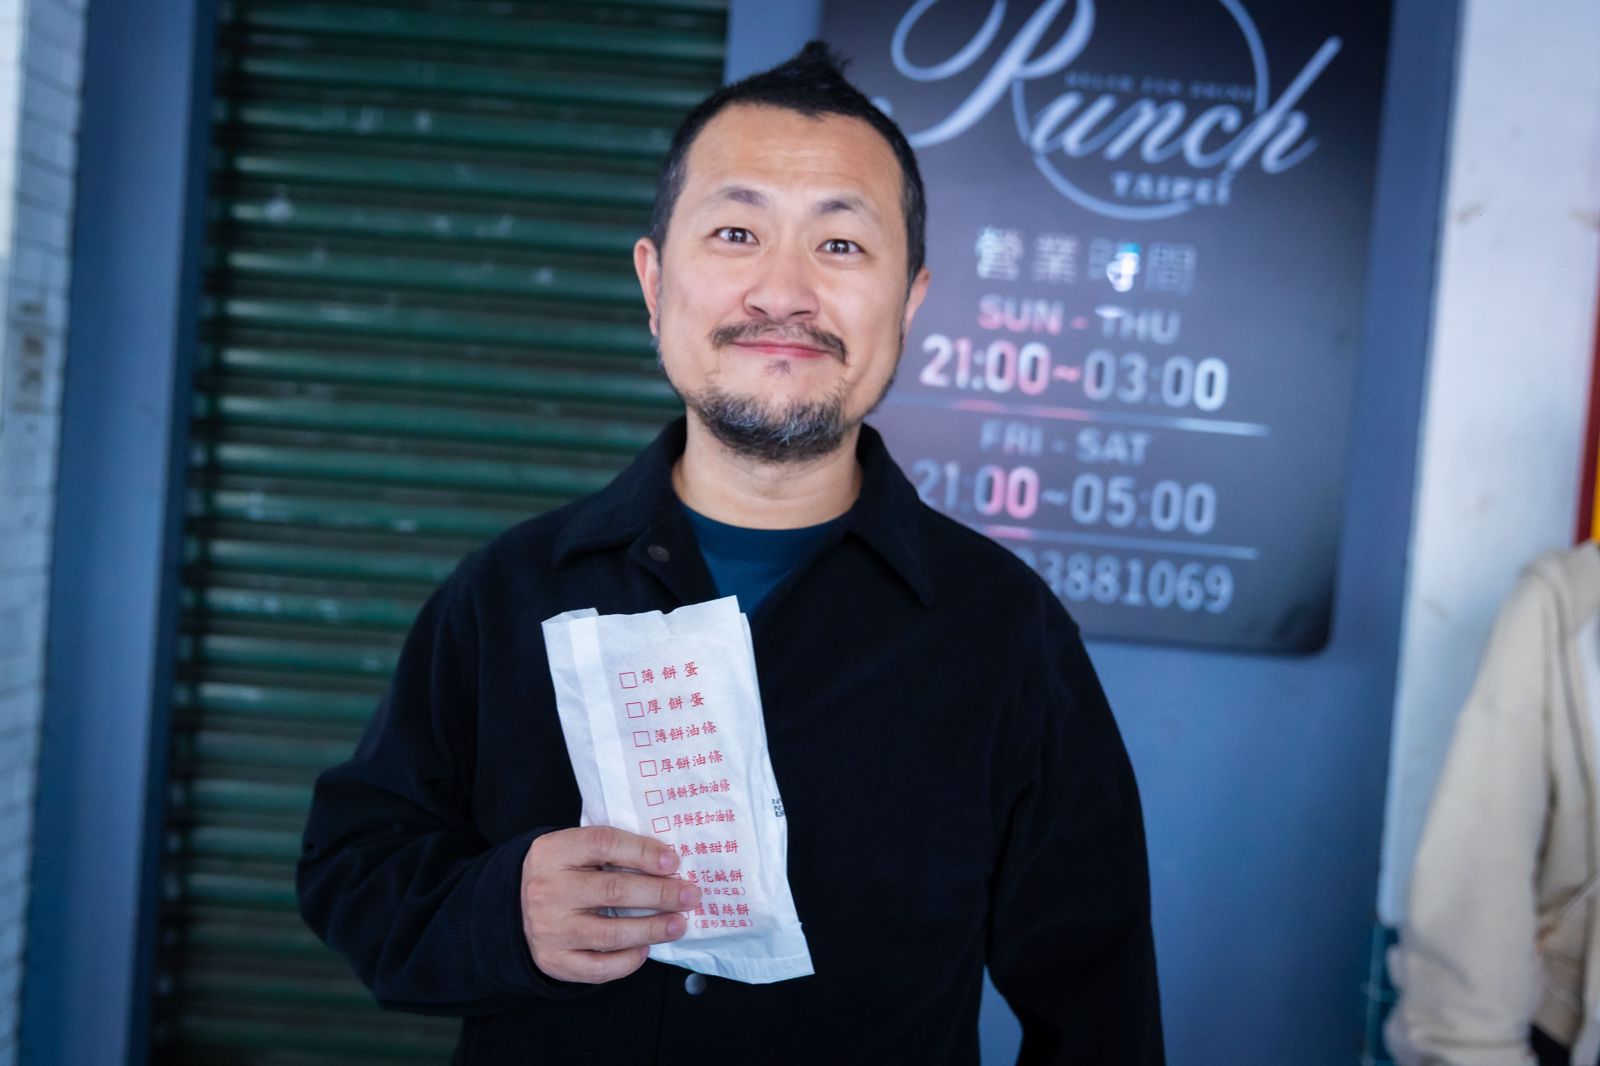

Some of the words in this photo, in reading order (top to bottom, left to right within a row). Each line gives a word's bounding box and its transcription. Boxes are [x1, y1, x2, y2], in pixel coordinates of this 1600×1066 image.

[1111, 170, 1233, 206] TAIPEI
[979, 295, 1063, 335] SUN
[1096, 306, 1181, 344] THU
[979, 420, 1043, 457] FRI
[1076, 425, 1151, 465] SAT
[1016, 548, 1235, 613] 3881069
[641, 661, 699, 683] 薄餅蛋
[648, 692, 704, 713] 厚餅蛋
[655, 721, 717, 743] 薄餅油條
[661, 749, 723, 772] 厚餅油條
[667, 778, 730, 800] 薄餅蛋加油條
[673, 808, 735, 827] 厚餅蛋加油條
[680, 839, 738, 857] 焦糖甜餅
